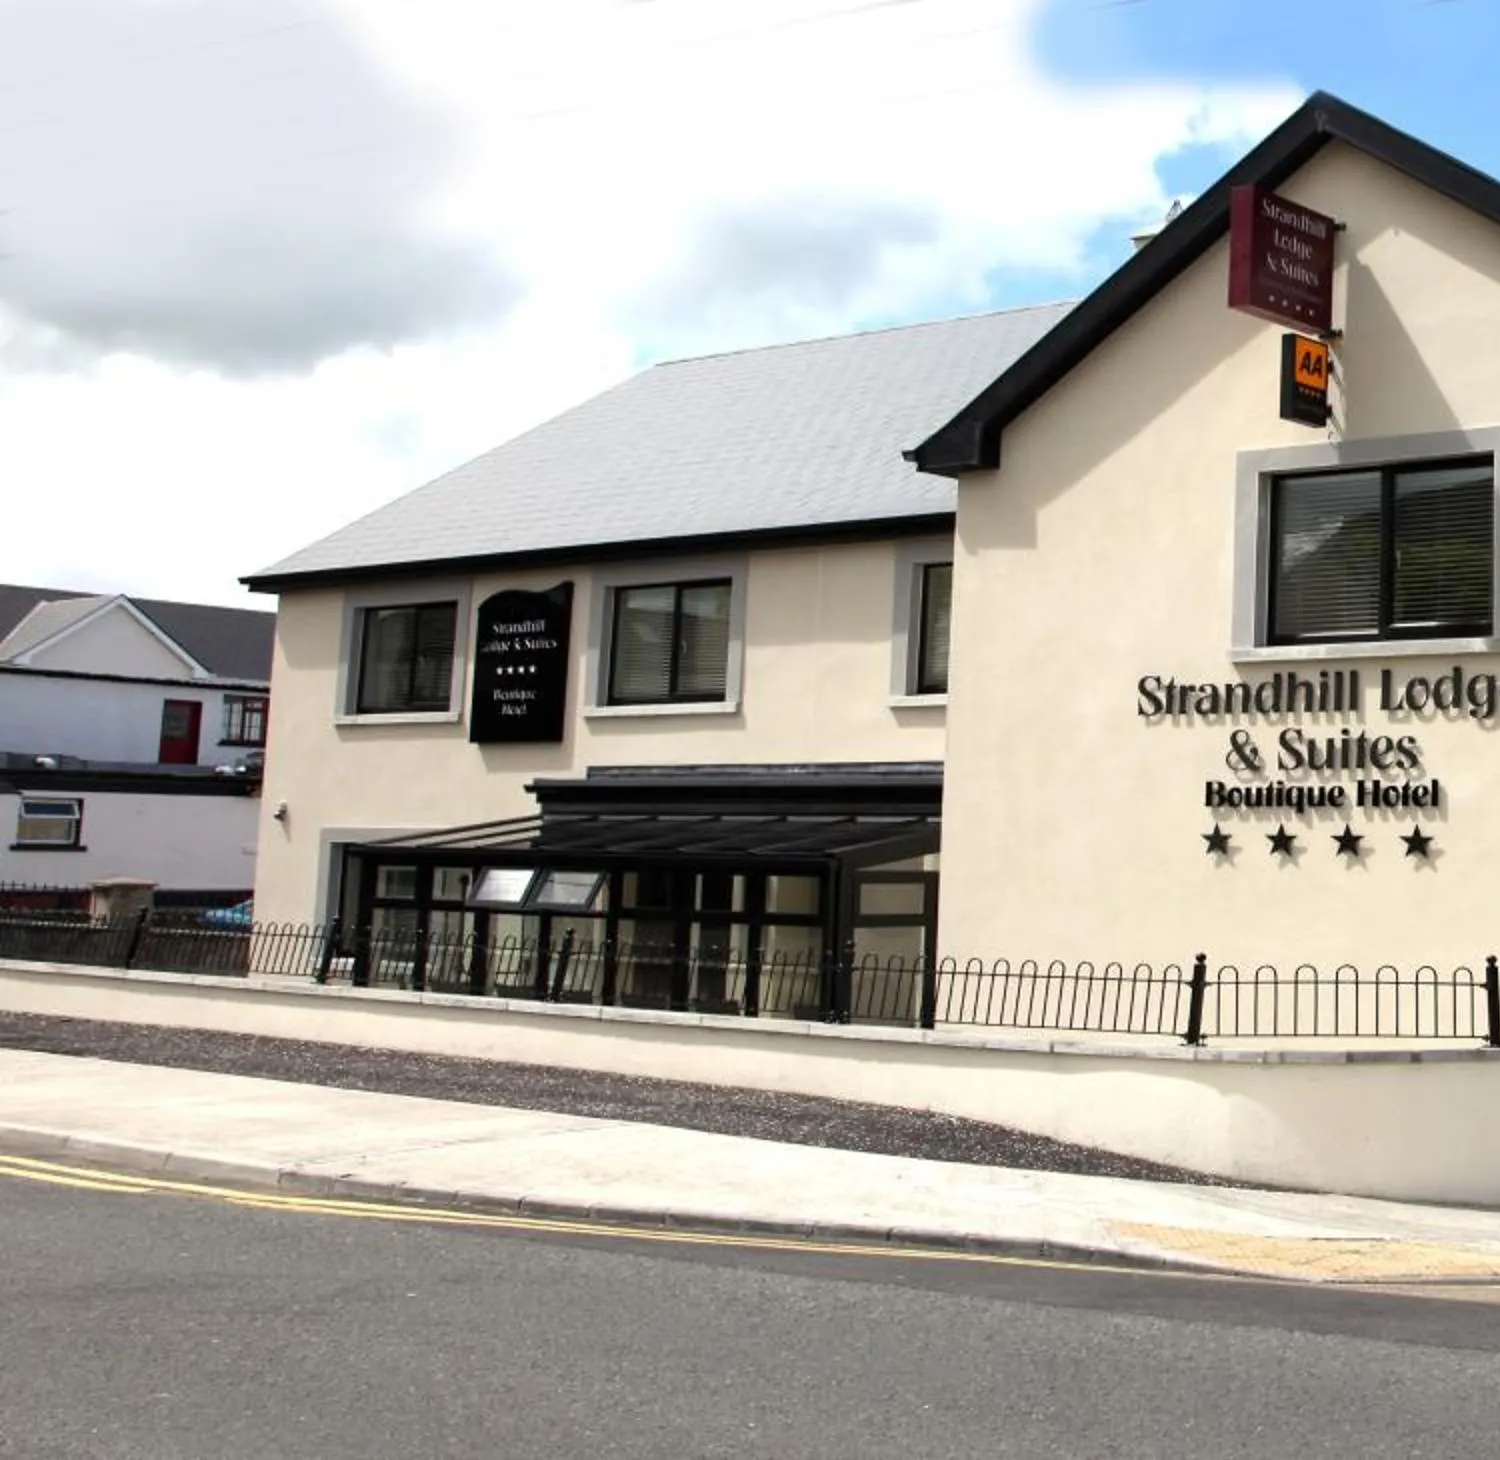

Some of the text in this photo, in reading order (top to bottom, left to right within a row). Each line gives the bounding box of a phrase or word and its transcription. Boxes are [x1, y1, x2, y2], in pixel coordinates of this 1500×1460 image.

[1262, 198, 1327, 240] Strandhill
[1273, 228, 1314, 261] Lodge
[1265, 253, 1319, 286] & Suites
[1299, 351, 1323, 377] AA
[1137, 669, 1360, 717] Strandhill
[1225, 726, 1422, 772] & Suites
[1204, 778, 1440, 814] Boutique Hotel
